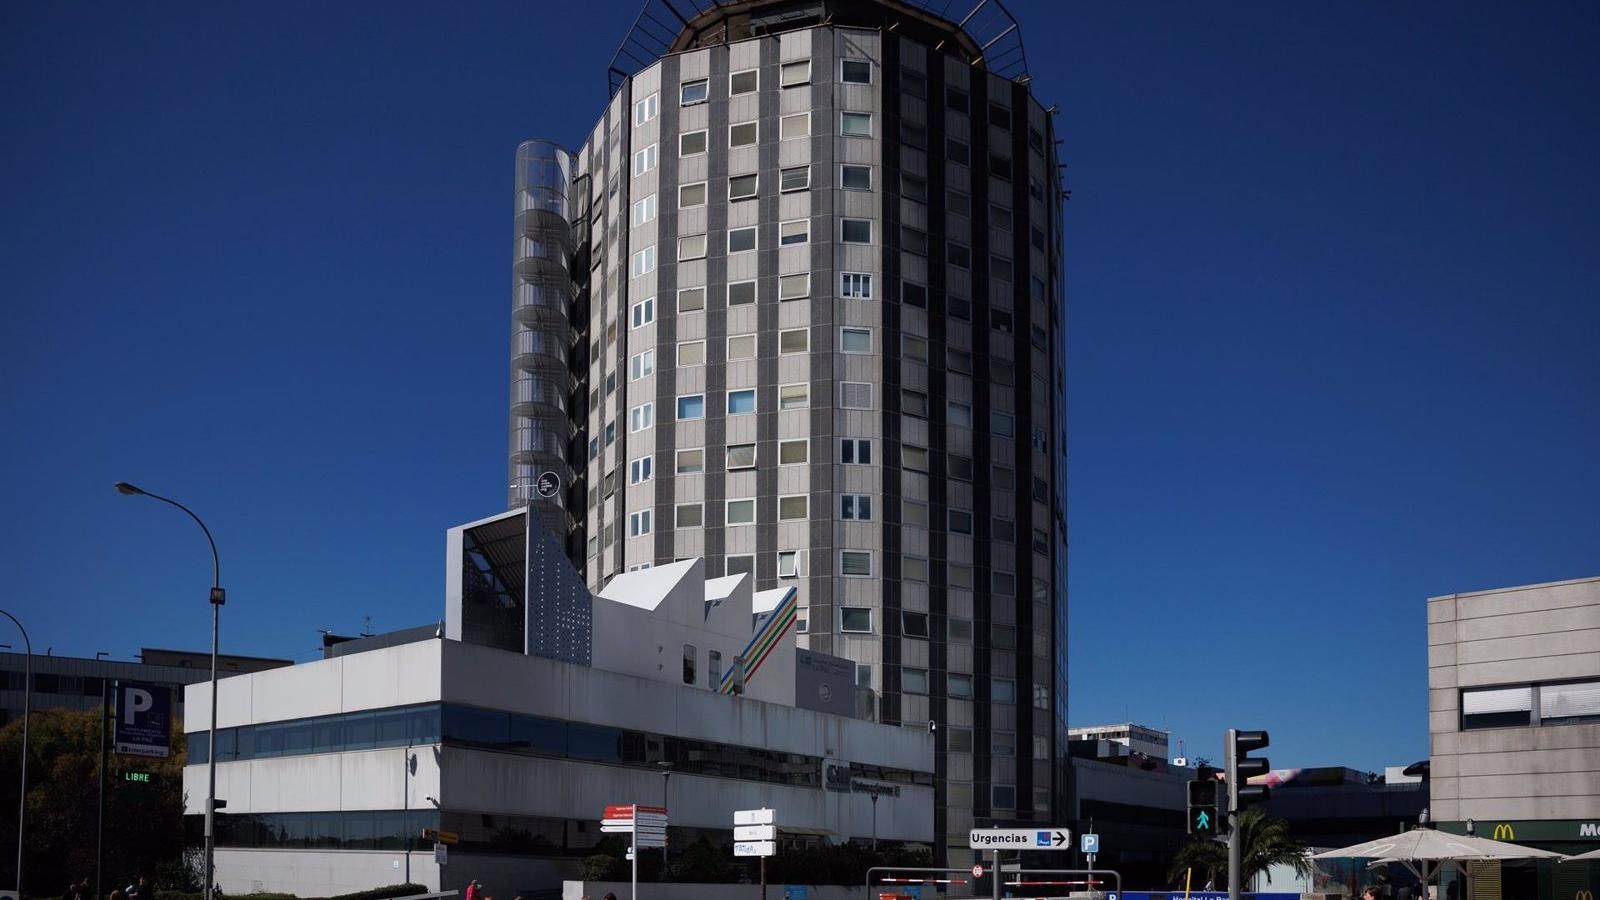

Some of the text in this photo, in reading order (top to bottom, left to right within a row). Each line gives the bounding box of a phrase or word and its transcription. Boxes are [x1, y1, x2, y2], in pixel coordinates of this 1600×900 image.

[125, 688, 152, 725] P
[125, 772, 150, 782] LIBRE
[972, 834, 1028, 844] Urgencias
[1085, 836, 1095, 850] P
